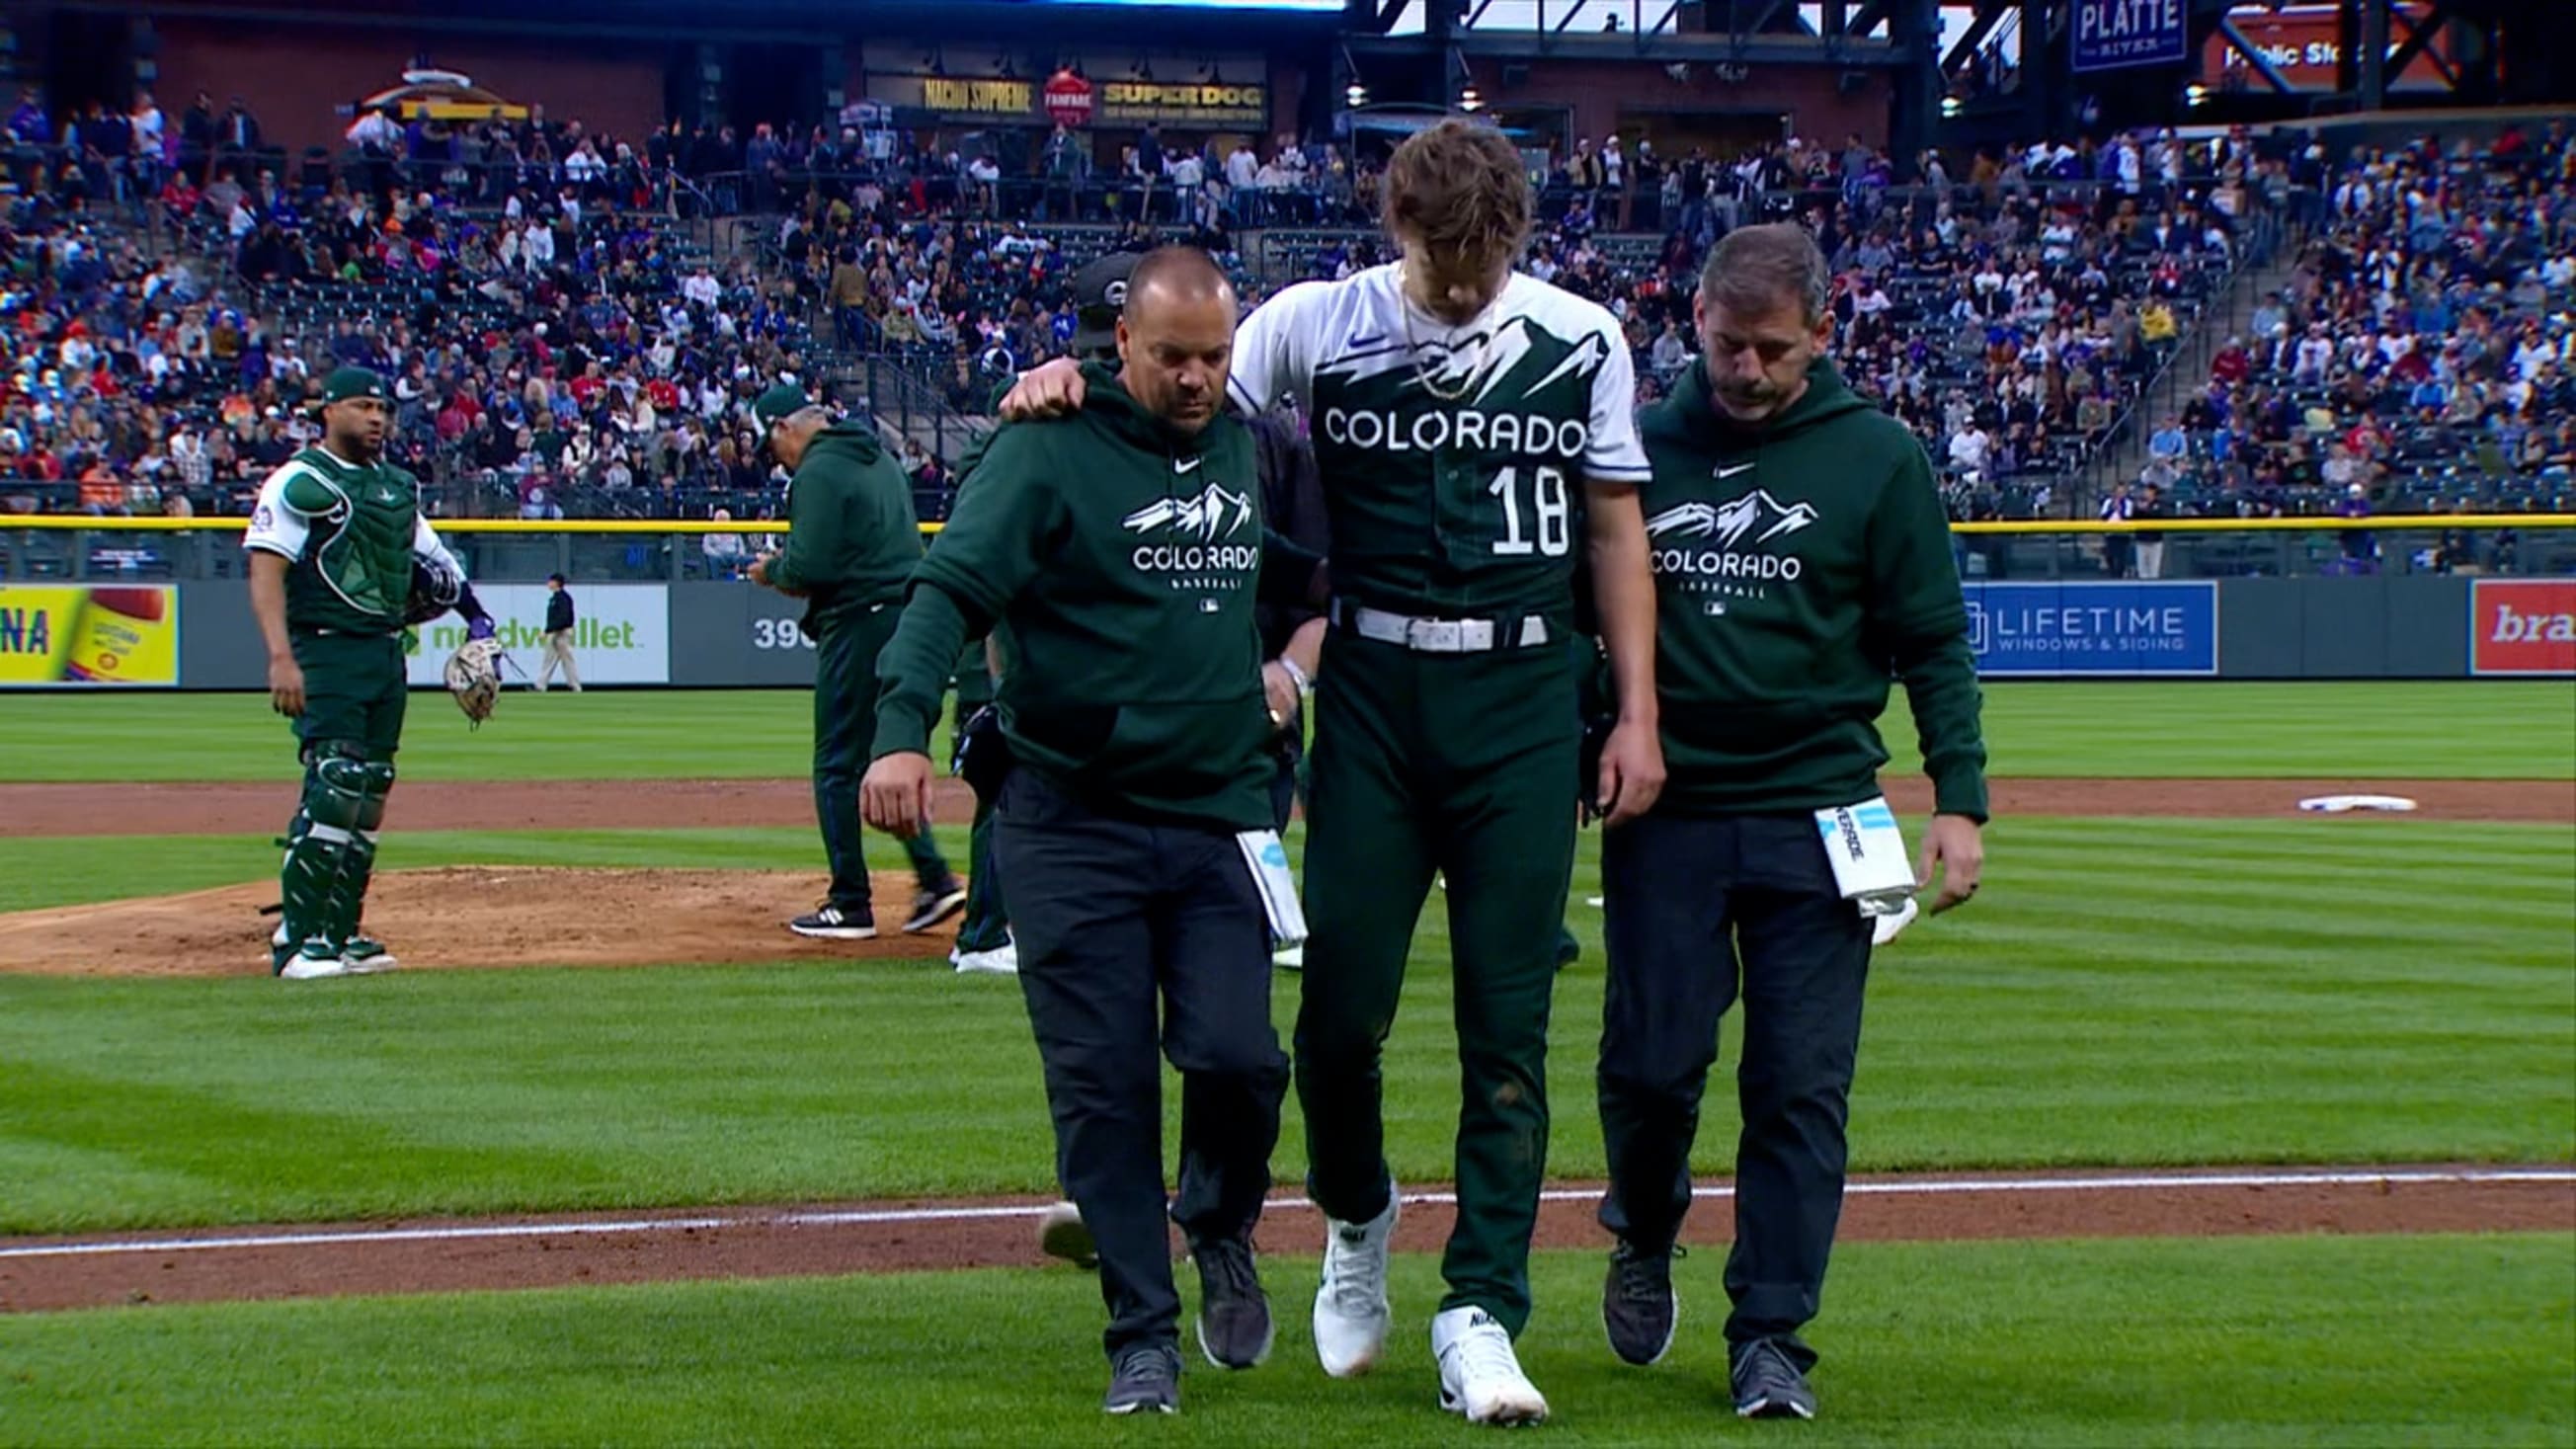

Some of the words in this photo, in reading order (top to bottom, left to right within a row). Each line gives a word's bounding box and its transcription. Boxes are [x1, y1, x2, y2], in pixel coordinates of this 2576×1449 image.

[2080, 0, 2179, 40] PLATTE
[1103, 83, 1198, 105] SUPER
[1201, 85, 1262, 107] DOG
[1325, 407, 1587, 458] COLORADO
[1489, 465, 1570, 557] 18
[1132, 545, 1259, 571] COLORADO
[1649, 549, 1802, 581] COLORADO
[1996, 607, 2186, 635] LIFETIME
[1998, 638, 2093, 652] WINDOWS
[2098, 638, 2112, 652] &
[2118, 638, 2186, 652] SIDING
